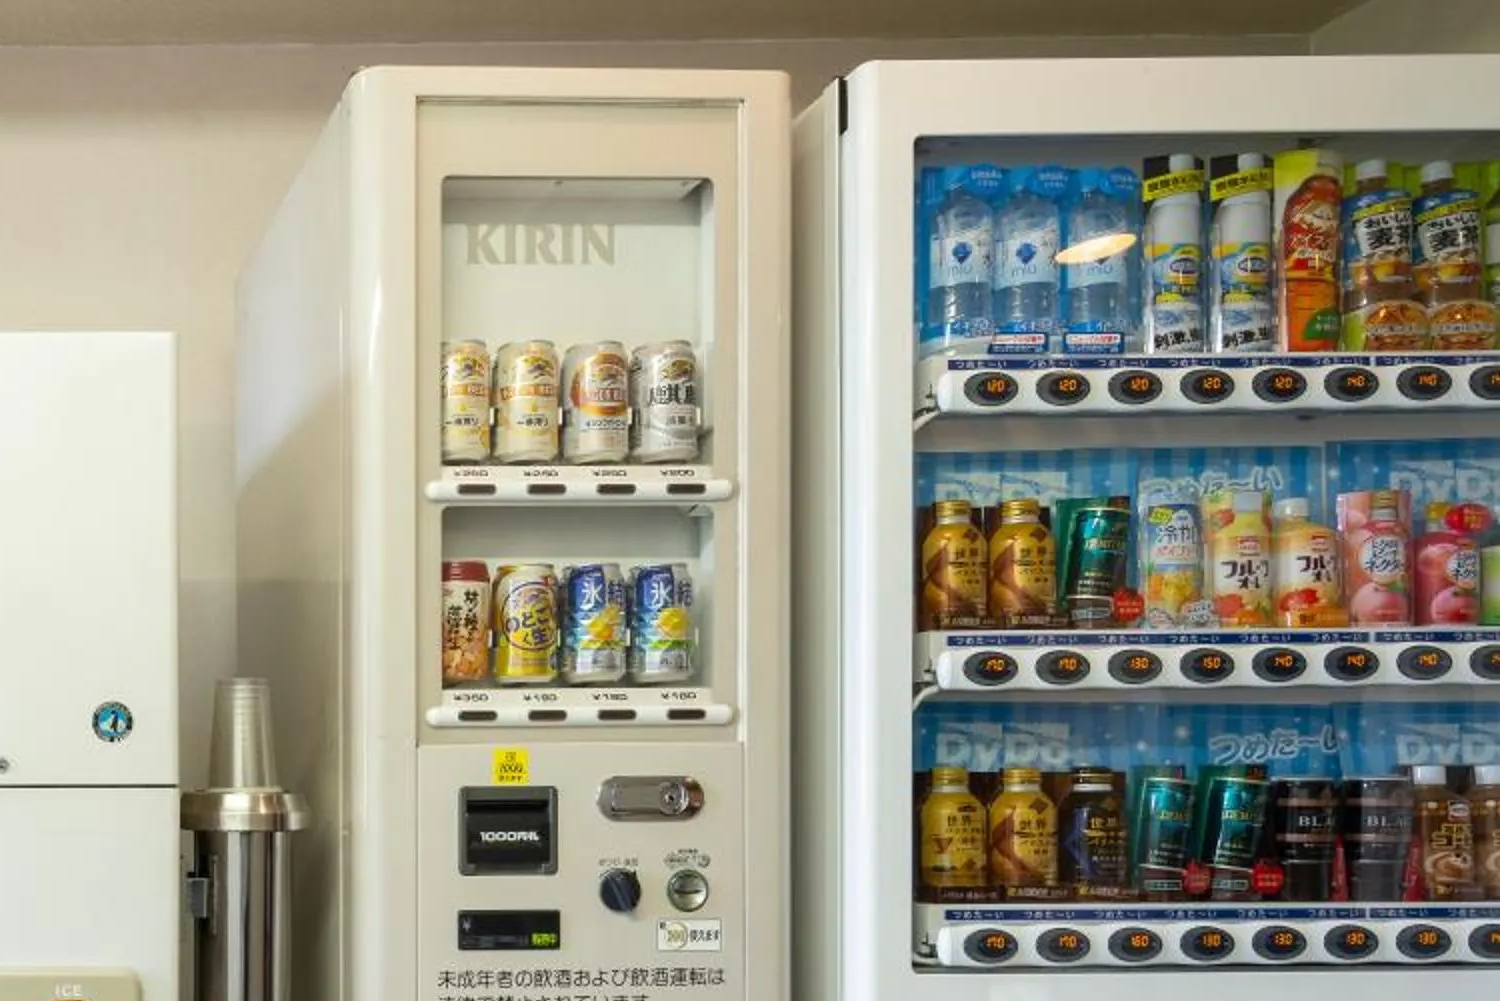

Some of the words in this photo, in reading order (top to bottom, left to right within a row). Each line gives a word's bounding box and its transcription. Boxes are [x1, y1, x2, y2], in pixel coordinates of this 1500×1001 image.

[466, 223, 615, 265] KIRIN
[987, 380, 1005, 392] 120
[1059, 379, 1077, 391] 120
[1203, 378, 1221, 389] 120
[1131, 657, 1149, 669] 130
[1274, 933, 1292, 945] 130
[1347, 933, 1365, 945] 130
[438, 968, 725, 989] 未成年者の飲酒および飲酒運転は
[55, 985, 82, 996] ICE
